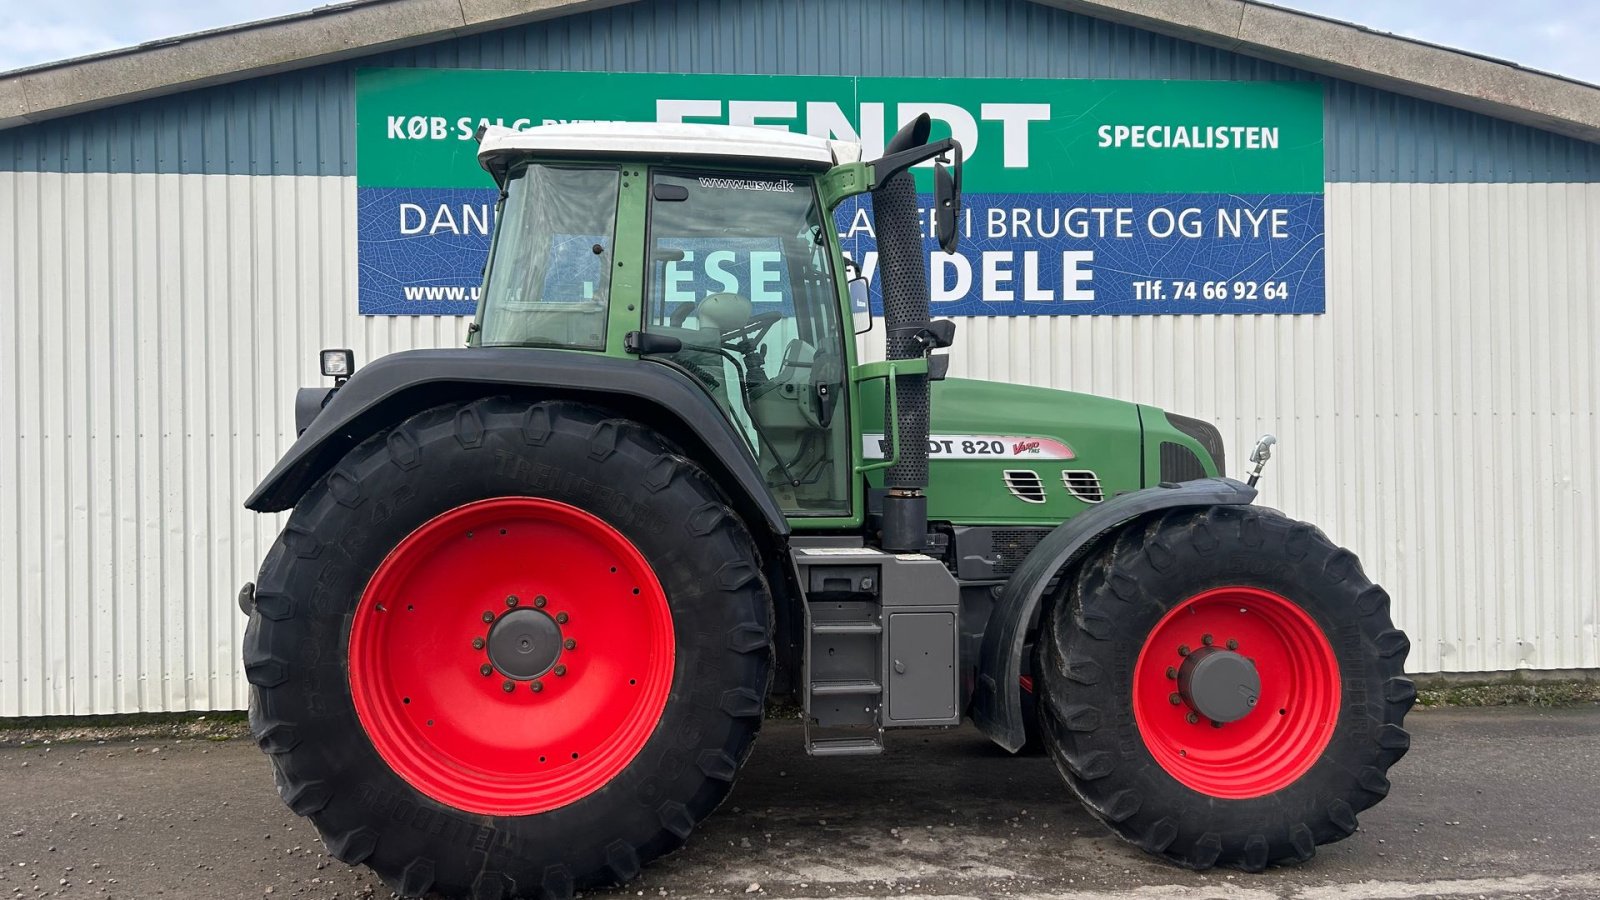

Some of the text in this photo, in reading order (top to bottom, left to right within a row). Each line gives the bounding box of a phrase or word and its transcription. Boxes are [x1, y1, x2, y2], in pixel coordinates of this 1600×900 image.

[1098, 125, 1279, 149] SPECIALISTEN
[699, 177, 794, 193] www.usv.dk
[987, 208, 1133, 238] BRUGTE
[1148, 208, 1202, 238] OG
[1218, 208, 1289, 239] NYE
[1133, 280, 1289, 300] Tlf. 74 66 92 64
[961, 440, 1005, 455] 820
